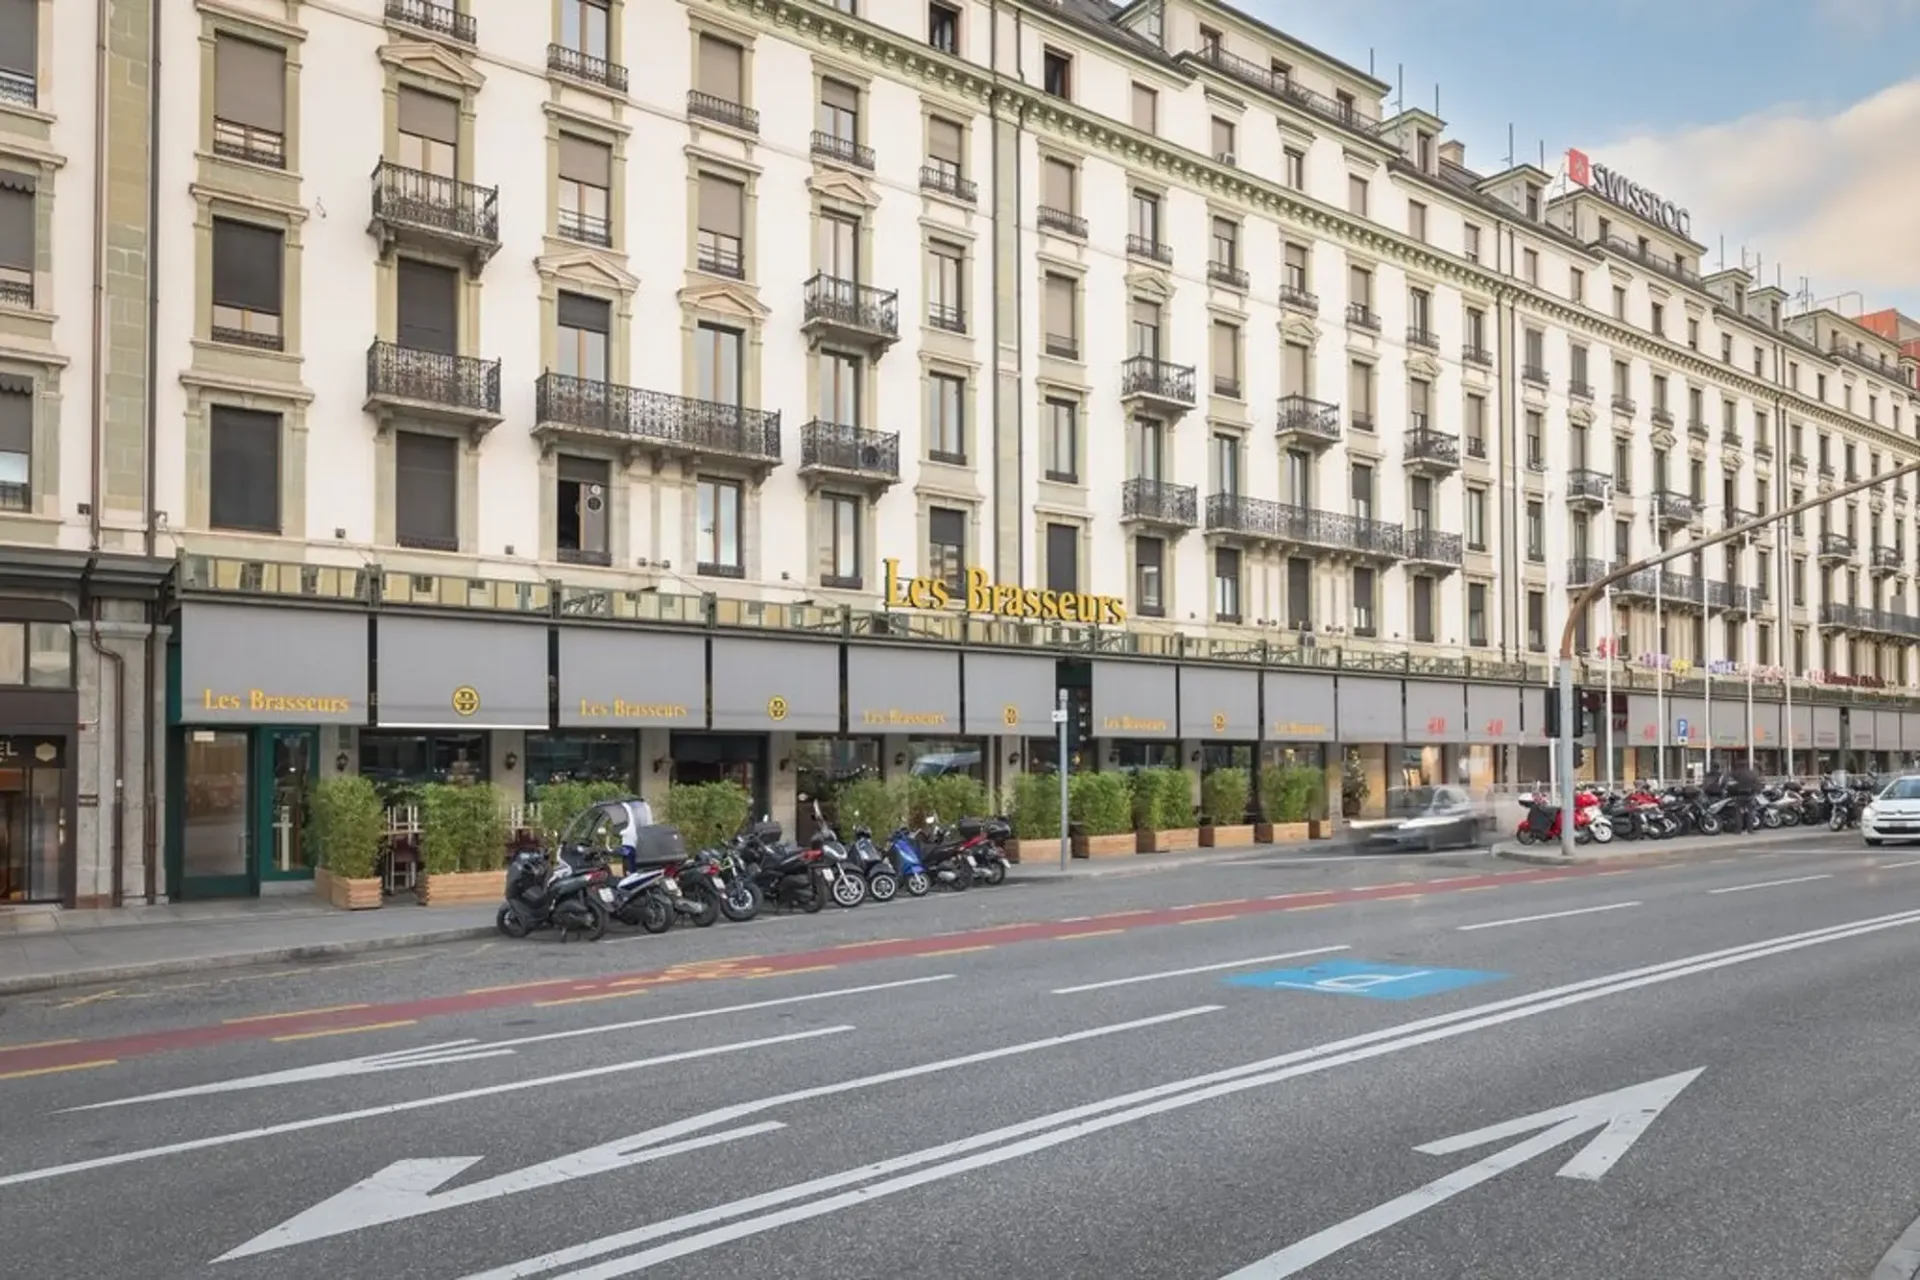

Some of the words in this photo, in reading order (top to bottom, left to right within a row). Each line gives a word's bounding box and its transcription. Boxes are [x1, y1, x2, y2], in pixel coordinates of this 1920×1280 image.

[883, 558, 950, 609] Les
[966, 566, 1127, 623] Brasseurs
[203, 688, 241, 708] Les
[248, 687, 350, 713] Brasseurs
[579, 698, 608, 717] Les
[613, 697, 688, 719] Brasseurs
